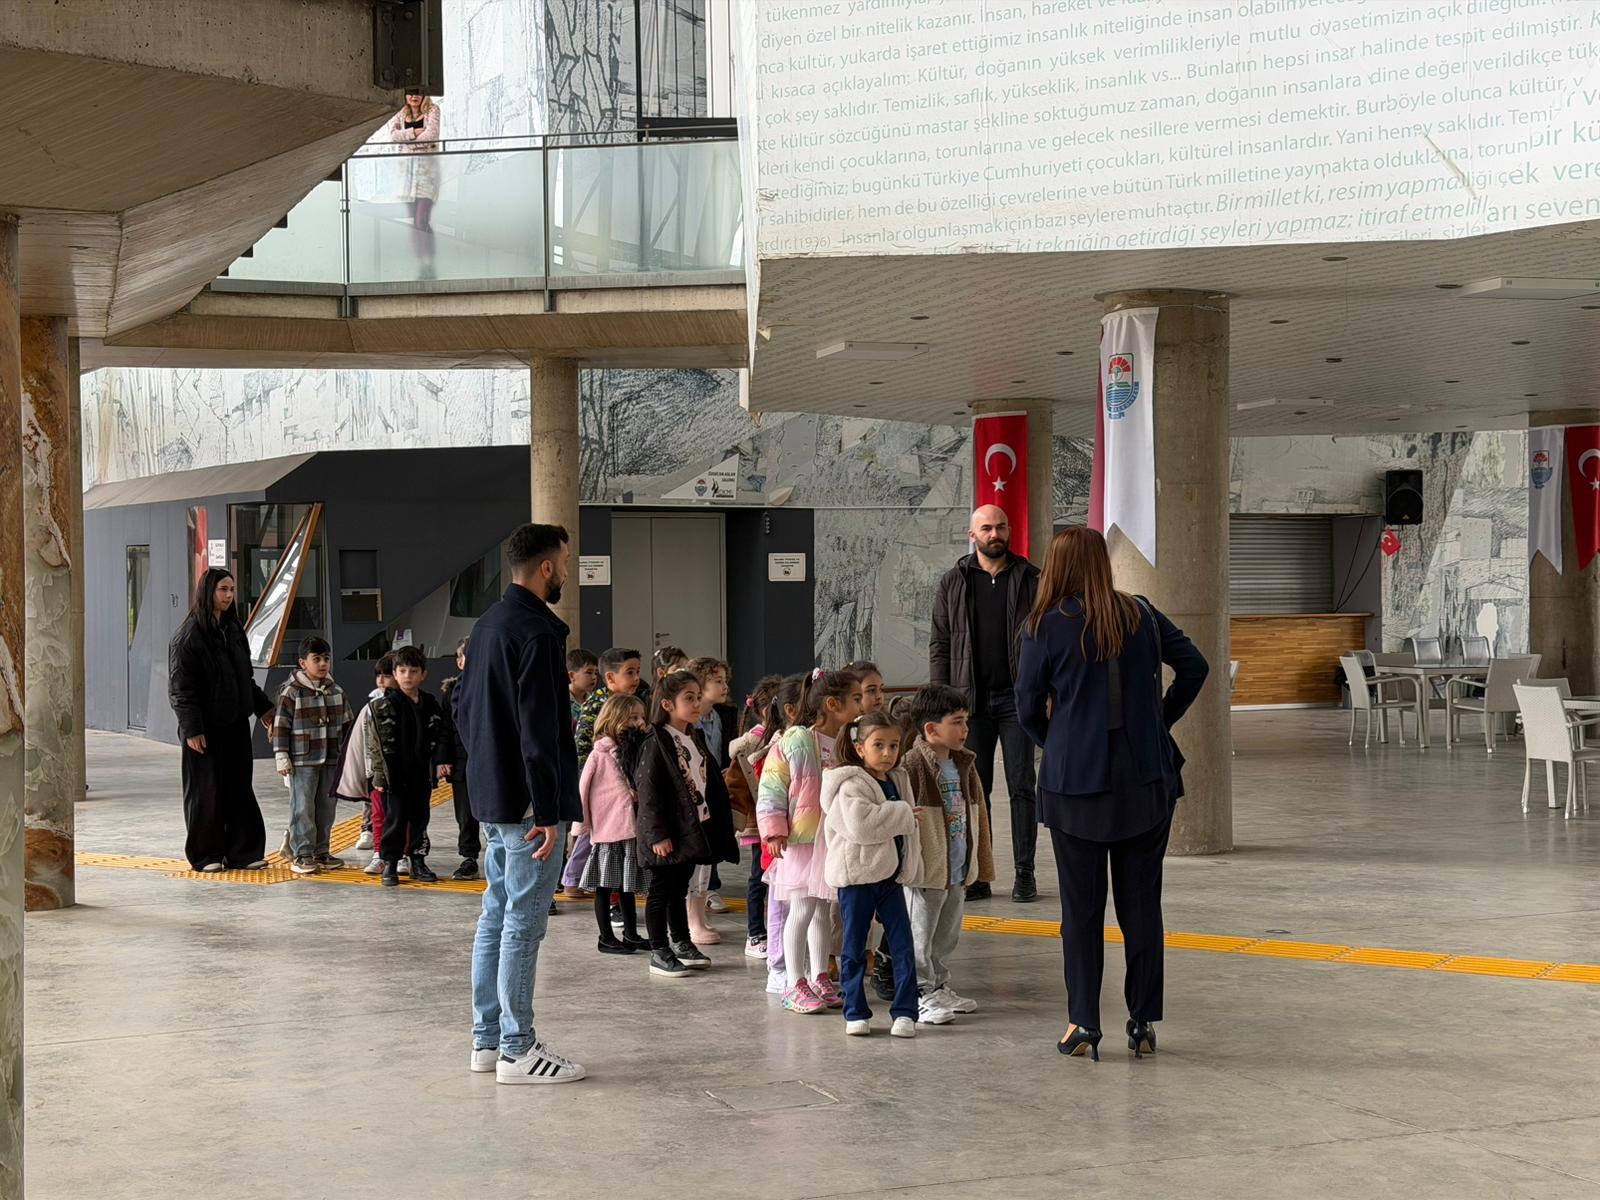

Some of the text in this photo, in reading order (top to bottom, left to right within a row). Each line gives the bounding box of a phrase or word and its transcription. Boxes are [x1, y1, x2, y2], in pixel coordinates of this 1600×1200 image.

[761, 33, 801, 51] diyen
[807, 25, 835, 43] özel
[842, 24, 861, 39] bir
[867, 16, 912, 36] nitelik
[917, 13, 974, 30] kazanır.
[1032, 0, 1092, 15] hareket
[767, 2, 840, 20] tükenmez
[790, 54, 834, 72] kültür,
[840, 45, 900, 70] yukarda
[906, 41, 947, 62] işaret
[952, 32, 1021, 54] ettiğimiz
[1027, 22, 1088, 45] insanlık
[1093, 12, 1181, 35] niteliğinde
[1187, 8, 1232, 24] insan
[765, 107, 790, 129] çok
[795, 108, 818, 126] şey
[824, 99, 880, 118] saklıdır.
[882, 91, 949, 112] Temizlik,
[954, 86, 997, 105] saflık,
[1002, 77, 1079, 104] yükseklik,
[1085, 69, 1147, 90] insanlık
[1151, 70, 1181, 83] vs...
[1187, 59, 1256, 78] Bunların
[1263, 50, 1310, 71] hepsi
[1362, 35, 1428, 56] halinde
[1436, 28, 1486, 48] tespit
[1492, 17, 1582, 40] edilmiştir.
[771, 83, 815, 98] kısaca
[823, 71, 910, 96] açıklayalım;
[918, 65, 968, 83] Kültür,
[975, 58, 1041, 78] doğanın
[1049, 46, 1105, 72] yüksek
[1113, 31, 1240, 60] verimlilikleriyle
[1249, 24, 1300, 43] mutlu
[1426, 1, 1462, 23] açık
[781, 131, 824, 148] kültür
[829, 122, 910, 144] sözcüğünü
[916, 119, 968, 134] mastar
[974, 111, 1028, 134] şekline
[1034, 101, 1136, 122] soktuğumuz
[1140, 96, 1199, 112] zaman,
[1205, 86, 1276, 106] doğanın
[1283, 75, 1361, 95] insanlara
[1472, 49, 1561, 71] verildikçe
[794, 155, 835, 173] kendi
[840, 150, 930, 174] çocuklarına,
[936, 141, 1021, 161] torunlarına
[1027, 138, 1046, 150] ve
[1052, 126, 1114, 152] gelecek
[1120, 122, 1189, 140] nesillere
[1194, 111, 1261, 133] vermesi
[1268, 103, 1350, 124] demektir.
[1442, 87, 1501, 103] olunca
[1510, 78, 1566, 97] kültür,
[852, 173, 921, 195] bugünkü
[923, 168, 980, 186] Türkiye
[984, 157, 1082, 179] Cumhuriyeti
[1087, 150, 1164, 174] çocukları,
[1169, 140, 1232, 162] kültürel
[1238, 132, 1332, 155] insanlardır.
[1336, 124, 1372, 143] Yani
[1438, 113, 1504, 131] saklıdır.
[1507, 107, 1555, 125] Temi
[770, 206, 854, 226] sahibidirler,
[858, 203, 890, 219] hem
[895, 199, 914, 215] de
[917, 197, 937, 213] bu
[941, 191, 996, 211] özelliği
[1000, 186, 1087, 209] çevrelerine
[1090, 184, 1109, 197] ve
[1113, 177, 1162, 194] bütün
[1165, 171, 1202, 190] Türk
[1206, 167, 1280, 185] milletine
[1284, 157, 1369, 183] yaymakta
[903, 215, 1002, 243] olgunlaşmak
[1005, 215, 1032, 234] için
[1035, 212, 1066, 228] bazı
[1070, 208, 1127, 230] şeylere
[1128, 201, 1213, 220] muhtaçtır.
[1216, 194, 1244, 211] Bir
[1244, 189, 1300, 208] millet
[1303, 187, 1325, 205] ki,
[1327, 184, 1382, 202] resim
[1115, 225, 1196, 249] getirdiği
[1200, 219, 1262, 244] şeyleri
[1265, 216, 1353, 238] yapmaz;
[1358, 205, 1410, 227] itiraf
